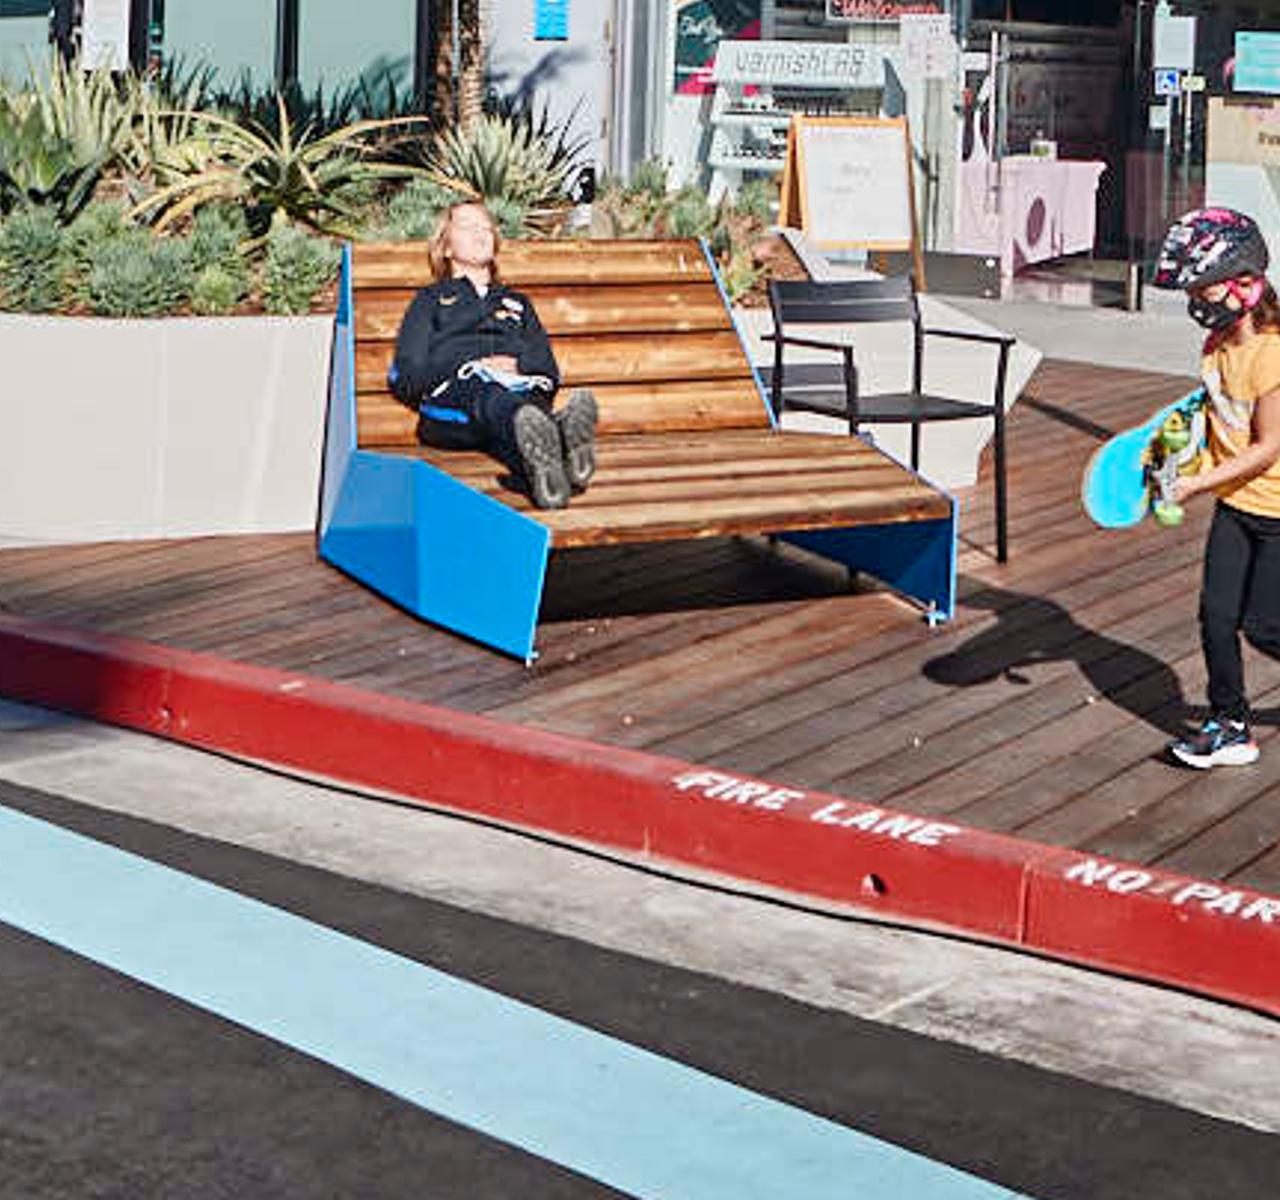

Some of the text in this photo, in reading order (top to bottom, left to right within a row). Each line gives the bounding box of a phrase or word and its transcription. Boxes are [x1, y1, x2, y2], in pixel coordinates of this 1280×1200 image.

[671, 770, 963, 846] FIRE LANE
[1066, 857, 1153, 894] NO
